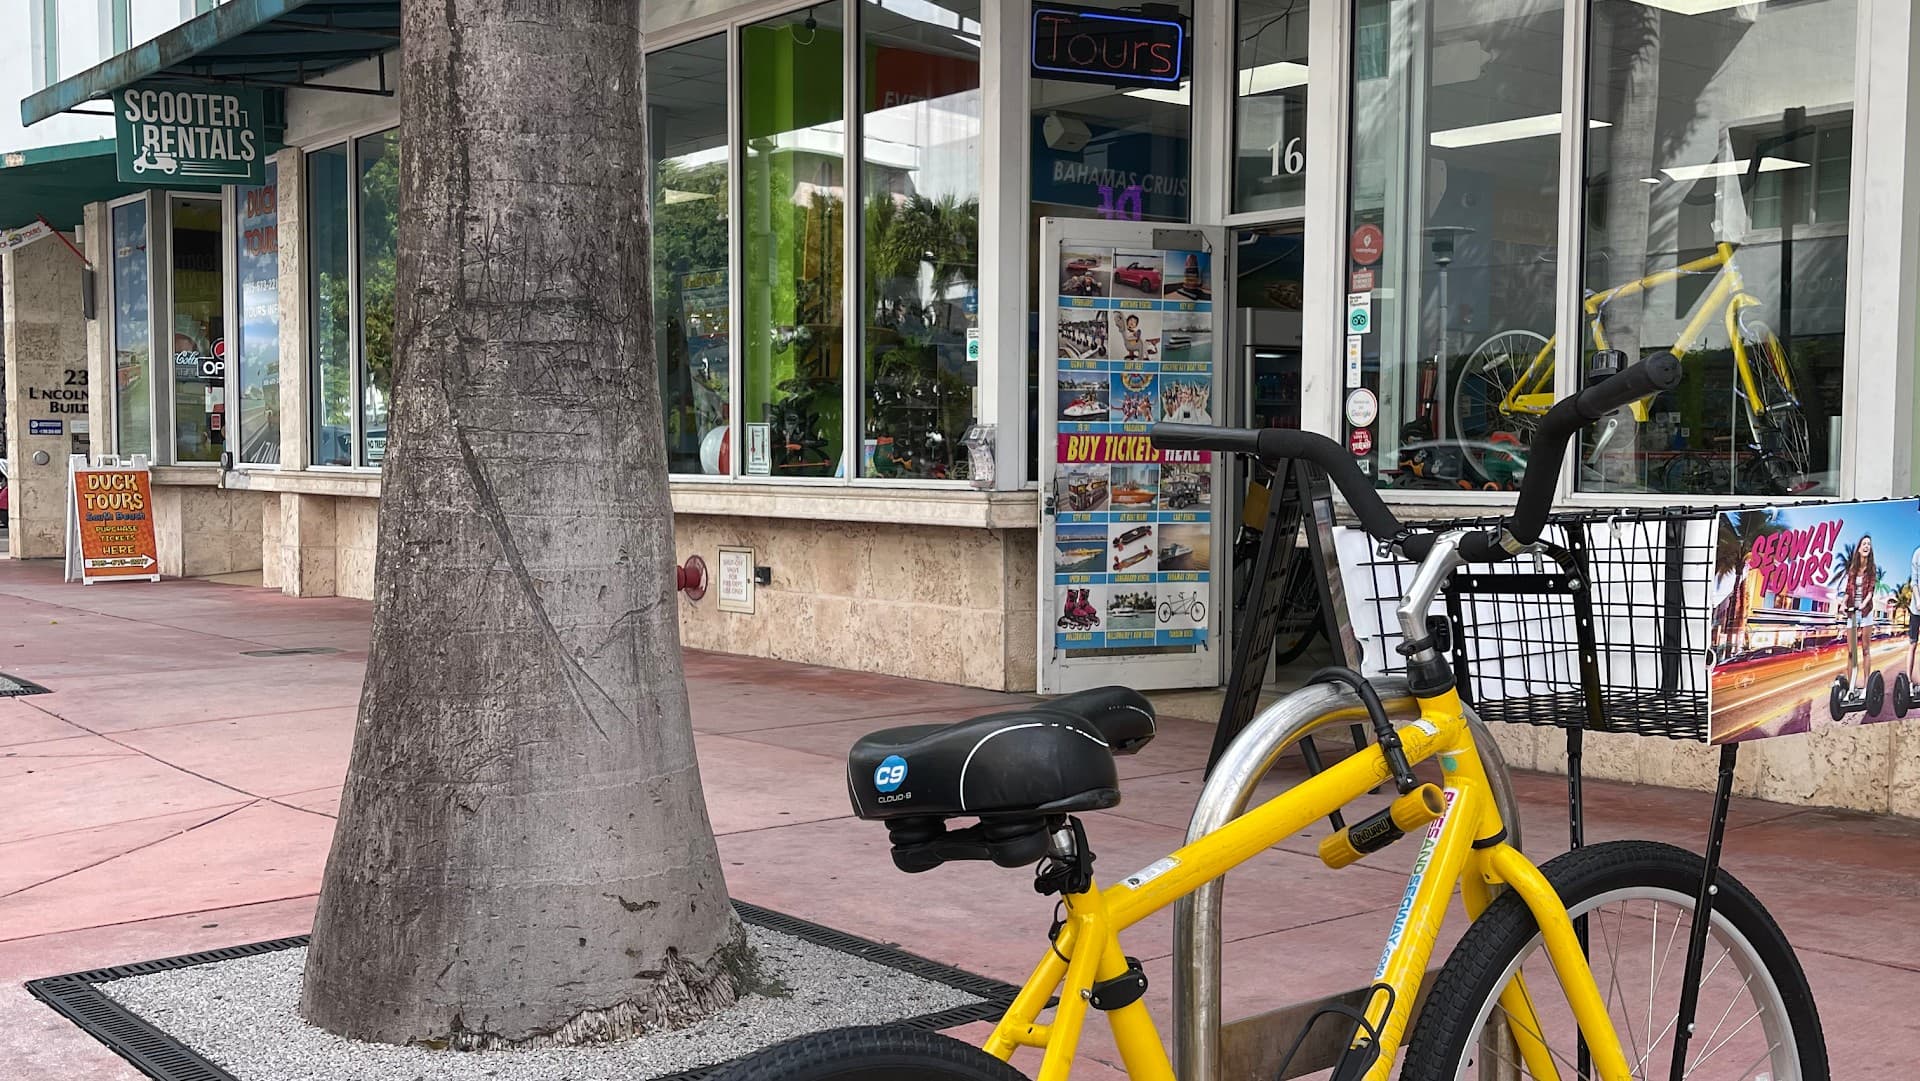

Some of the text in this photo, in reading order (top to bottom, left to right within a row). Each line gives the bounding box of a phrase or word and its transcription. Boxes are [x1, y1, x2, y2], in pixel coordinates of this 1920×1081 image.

[1041, 15, 1172, 74] Tours
[124, 88, 240, 127] SCOOTER
[143, 123, 256, 163] RENTALS
[1266, 136, 1305, 177] 16
[1053, 159, 1137, 190] BAHAMAS
[1066, 435, 1100, 462] BUY
[1104, 435, 1160, 462] TICKETS
[87, 473, 139, 491] DUCK
[84, 492, 145, 511] TOURS
[95, 525, 138, 533] PURCHASE
[101, 534, 136, 542] TICKETS
[102, 545, 136, 555] HERE
[1749, 517, 1845, 571] SEGWAY
[1759, 550, 1834, 599] TOURS
[876, 765, 905, 785] C9
[878, 791, 912, 804] CLOUD-9
